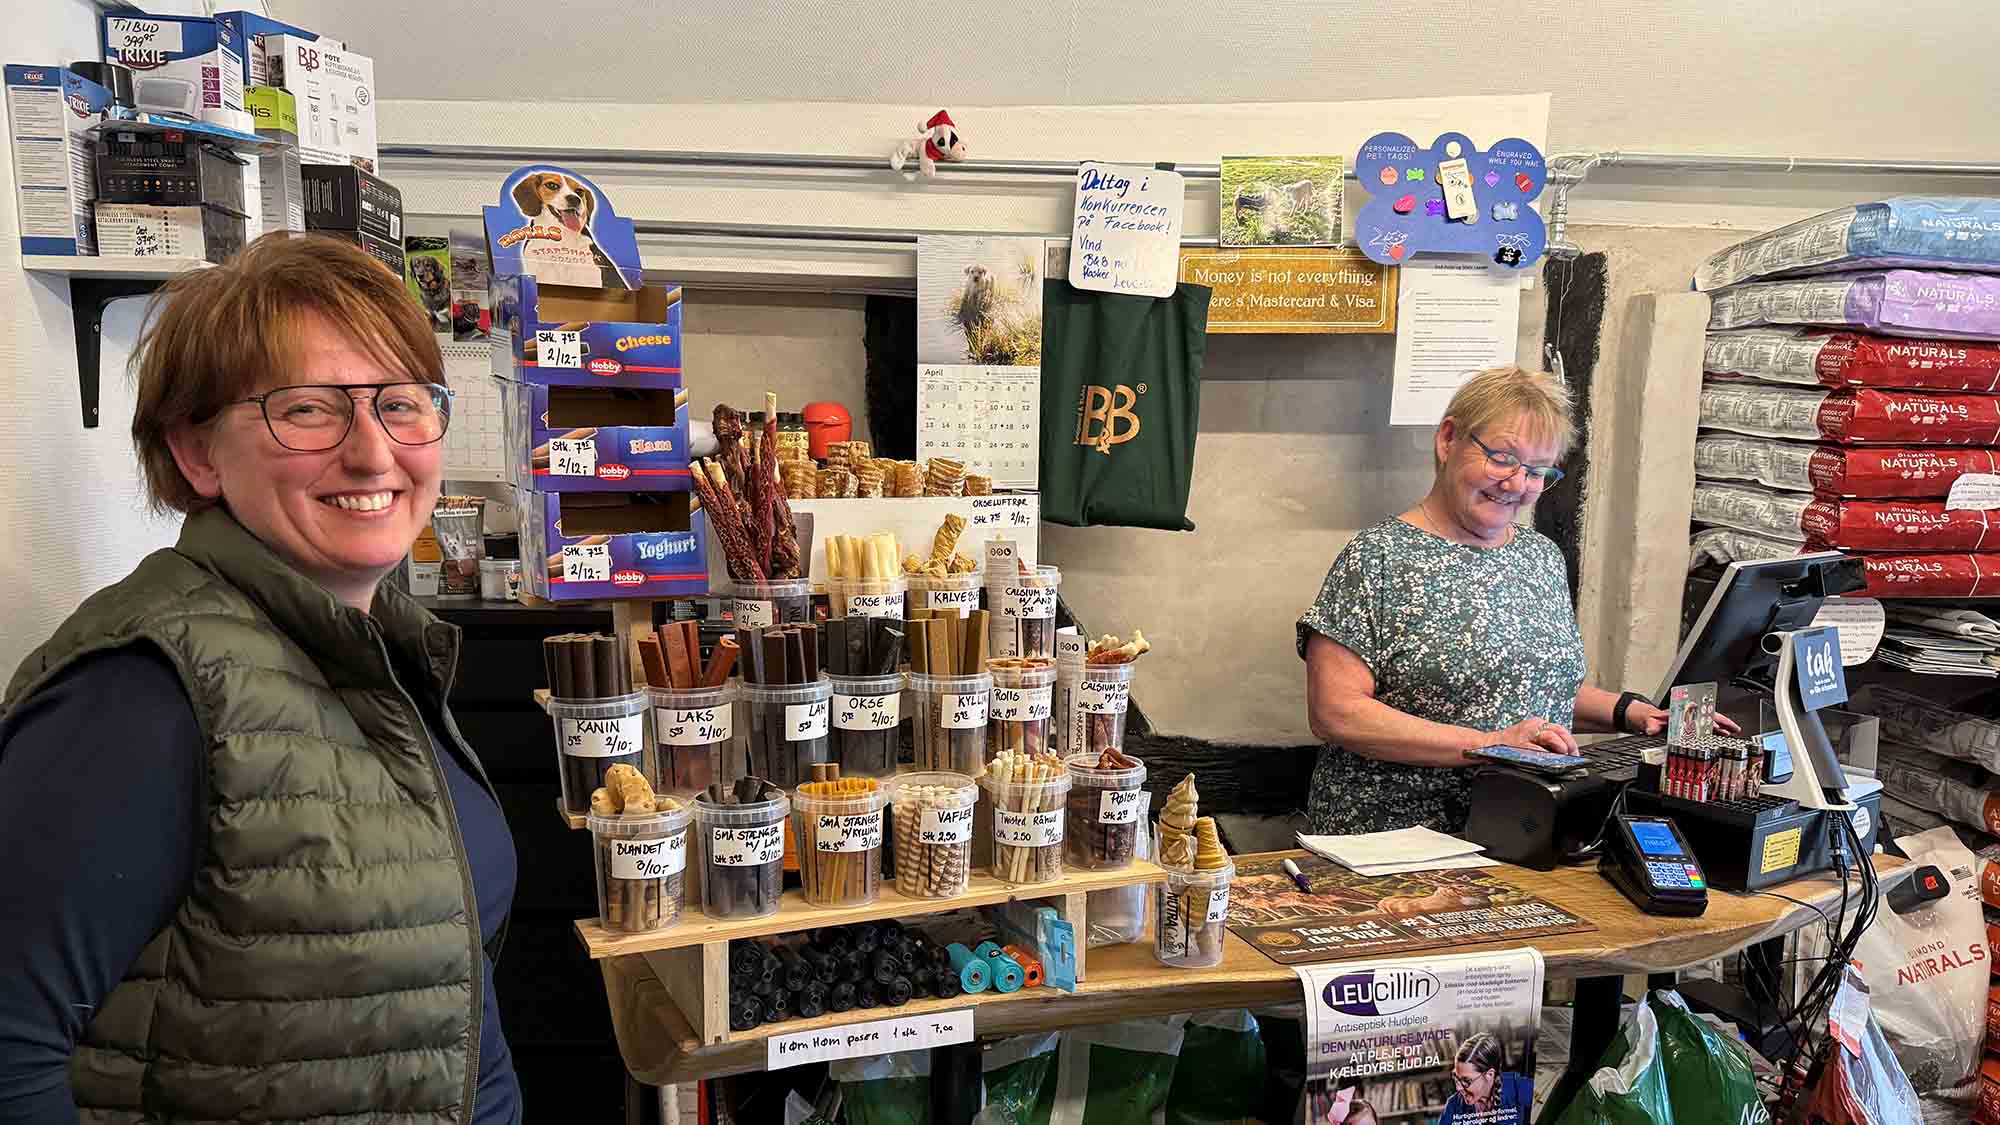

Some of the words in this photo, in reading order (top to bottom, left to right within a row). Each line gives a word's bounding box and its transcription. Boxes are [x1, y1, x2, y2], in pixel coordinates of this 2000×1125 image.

[117, 48, 167, 64] TRIXIE
[1195, 268, 1245, 286] Money
[1250, 269, 1264, 283] is
[1268, 269, 1291, 284] not
[1250, 294, 1325, 308] Mastercard
[1330, 294, 1340, 308] &
[1916, 287, 1994, 304] NATURALS
[615, 335, 672, 352] Cheese
[1890, 345, 1967, 359] NATURALS
[591, 361, 621, 374] Nobby
[924, 368, 944, 377] April
[1890, 402, 1968, 414] NATURALS
[629, 439, 673, 455] Ham
[1881, 458, 1958, 469] NATURALS
[599, 467, 629, 479] Nobby
[1875, 511, 1950, 524] NATURALS
[636, 536, 697, 560] Yoghurt
[1866, 561, 1943, 572] NATURALS
[615, 573, 645, 585] Nobby
[854, 596, 880, 607] OKSE
[849, 697, 885, 709] OKSE
[677, 710, 715, 723] LAKS
[577, 720, 620, 734] KANIN
[714, 829, 735, 841] SMÅ
[617, 841, 666, 856] BLANDET
[1897, 943, 1986, 986] NATURALS
[1331, 972, 1430, 1006] LEUcillin
[1334, 1020, 1386, 1033] Antiseptisk
[1388, 1015, 1428, 1027] Hudpleje
[1321, 1041, 1346, 1054] DEN
[1349, 1032, 1416, 1050] NATURLIGE
[1416, 1027, 1451, 1042] MÅDE
[1349, 1051, 1365, 1064] AT
[1367, 1045, 1403, 1060] PLEJE
[1404, 1044, 1423, 1056] DIT
[1329, 1061, 1395, 1080] KÆLEDYRS
[1397, 1057, 1422, 1070] HUD
[1424, 1052, 1441, 1066] PÅ
